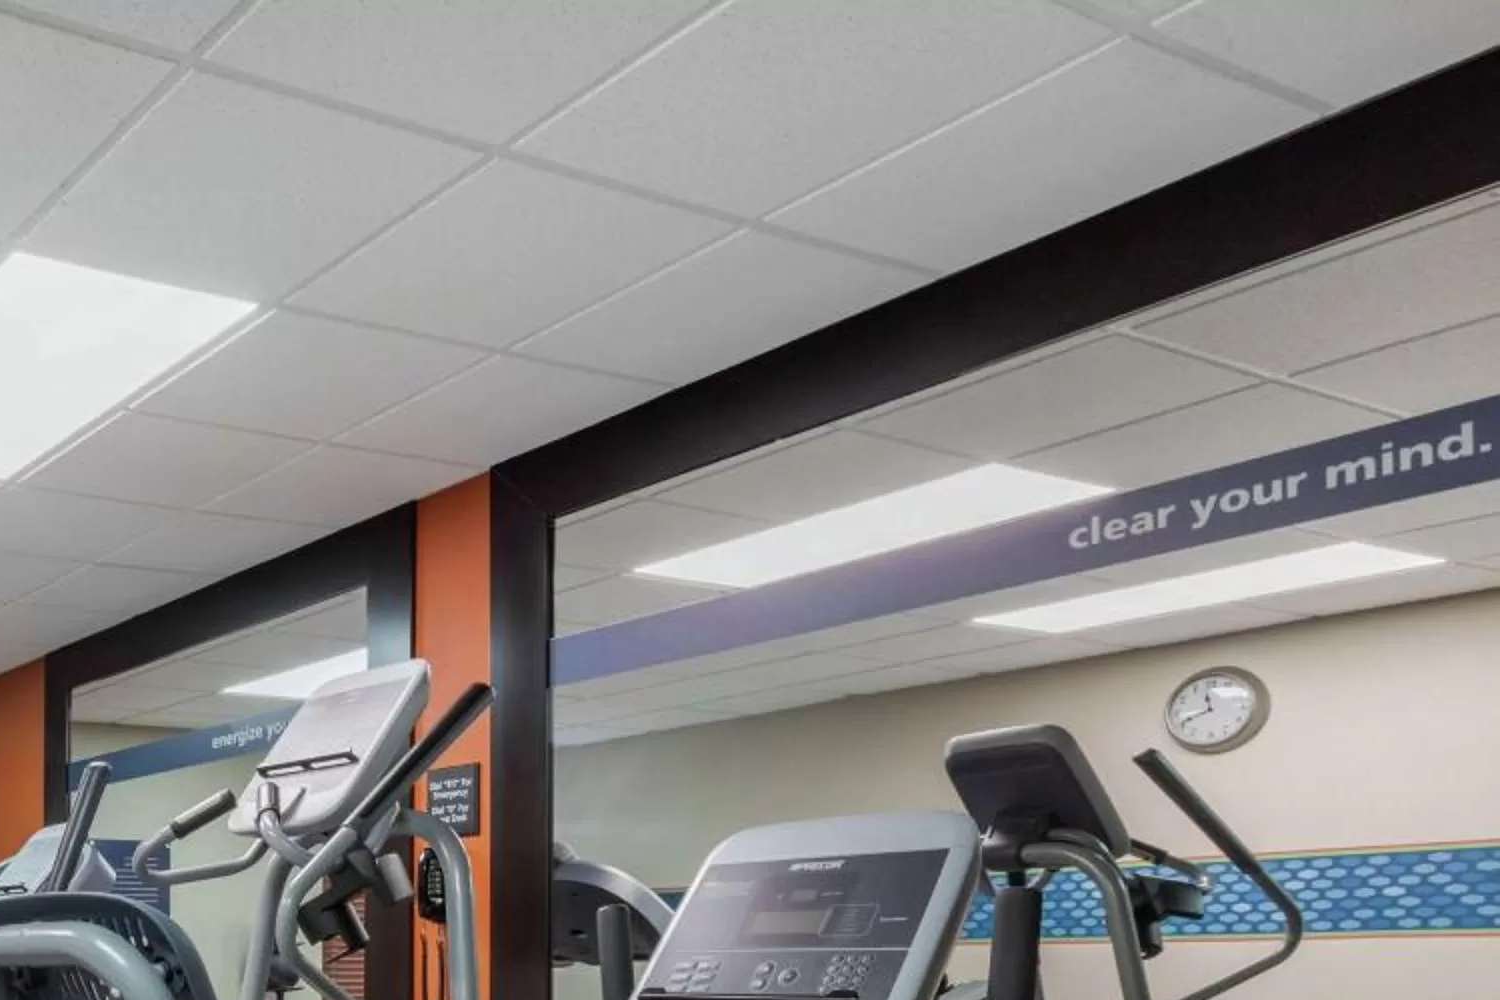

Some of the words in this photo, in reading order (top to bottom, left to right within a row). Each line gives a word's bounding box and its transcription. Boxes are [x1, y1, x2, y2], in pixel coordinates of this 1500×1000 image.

[1068, 505, 1176, 549] clear
[1190, 471, 1307, 530] your
[1325, 421, 1492, 490] mind.
[211, 724, 263, 749] energize
